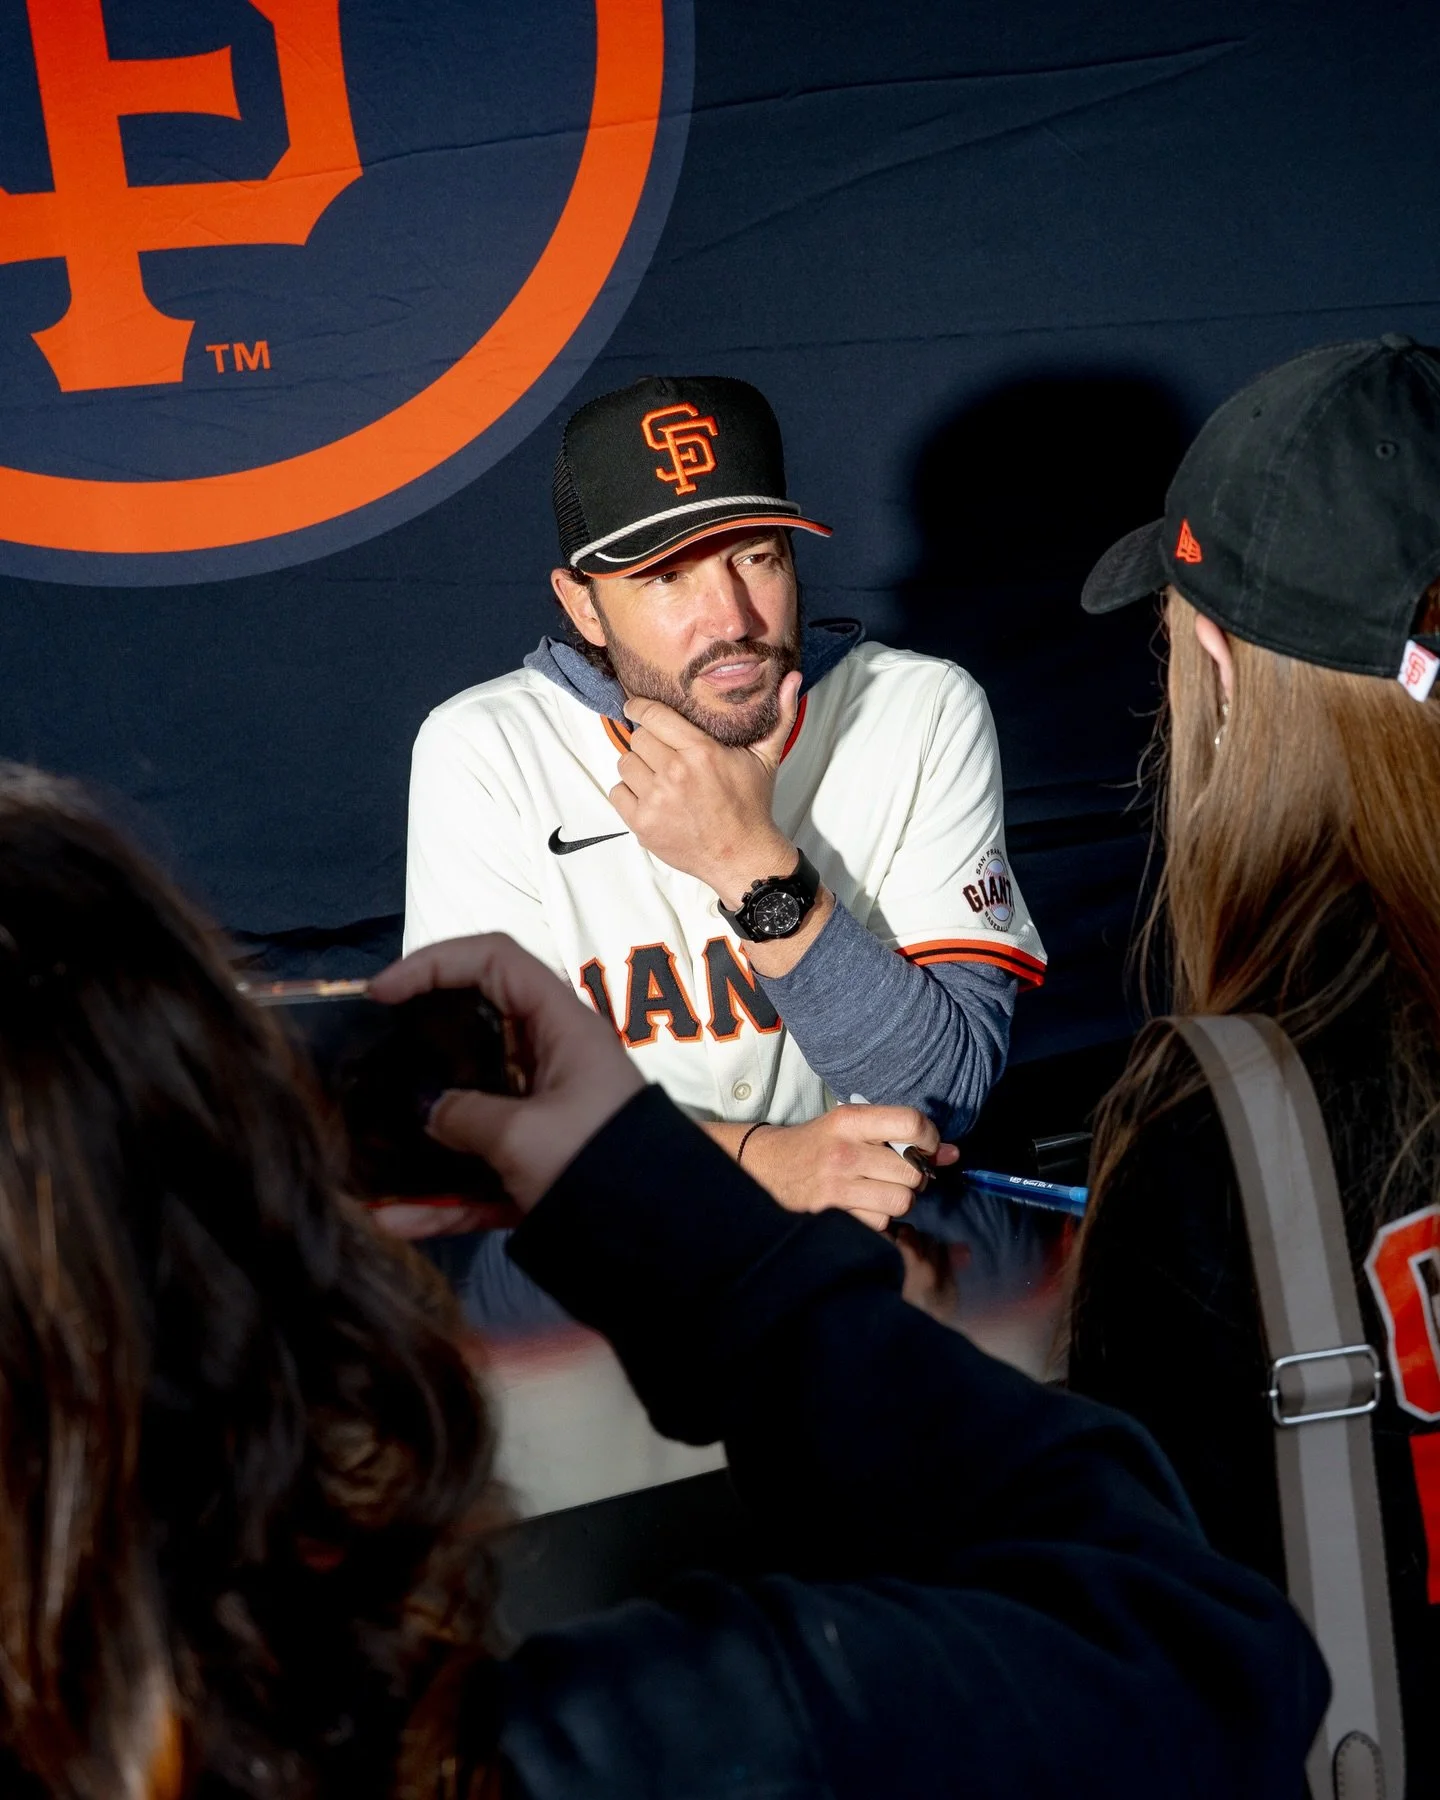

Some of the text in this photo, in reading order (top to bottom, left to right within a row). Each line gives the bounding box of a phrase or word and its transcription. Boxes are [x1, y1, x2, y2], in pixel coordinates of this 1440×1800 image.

[205, 340, 272, 374] TM
[641, 401, 718, 496] SF
[976, 856, 986, 875] SAN
[962, 875, 1012, 914] GIANT
[579, 935, 783, 1048] IAN
